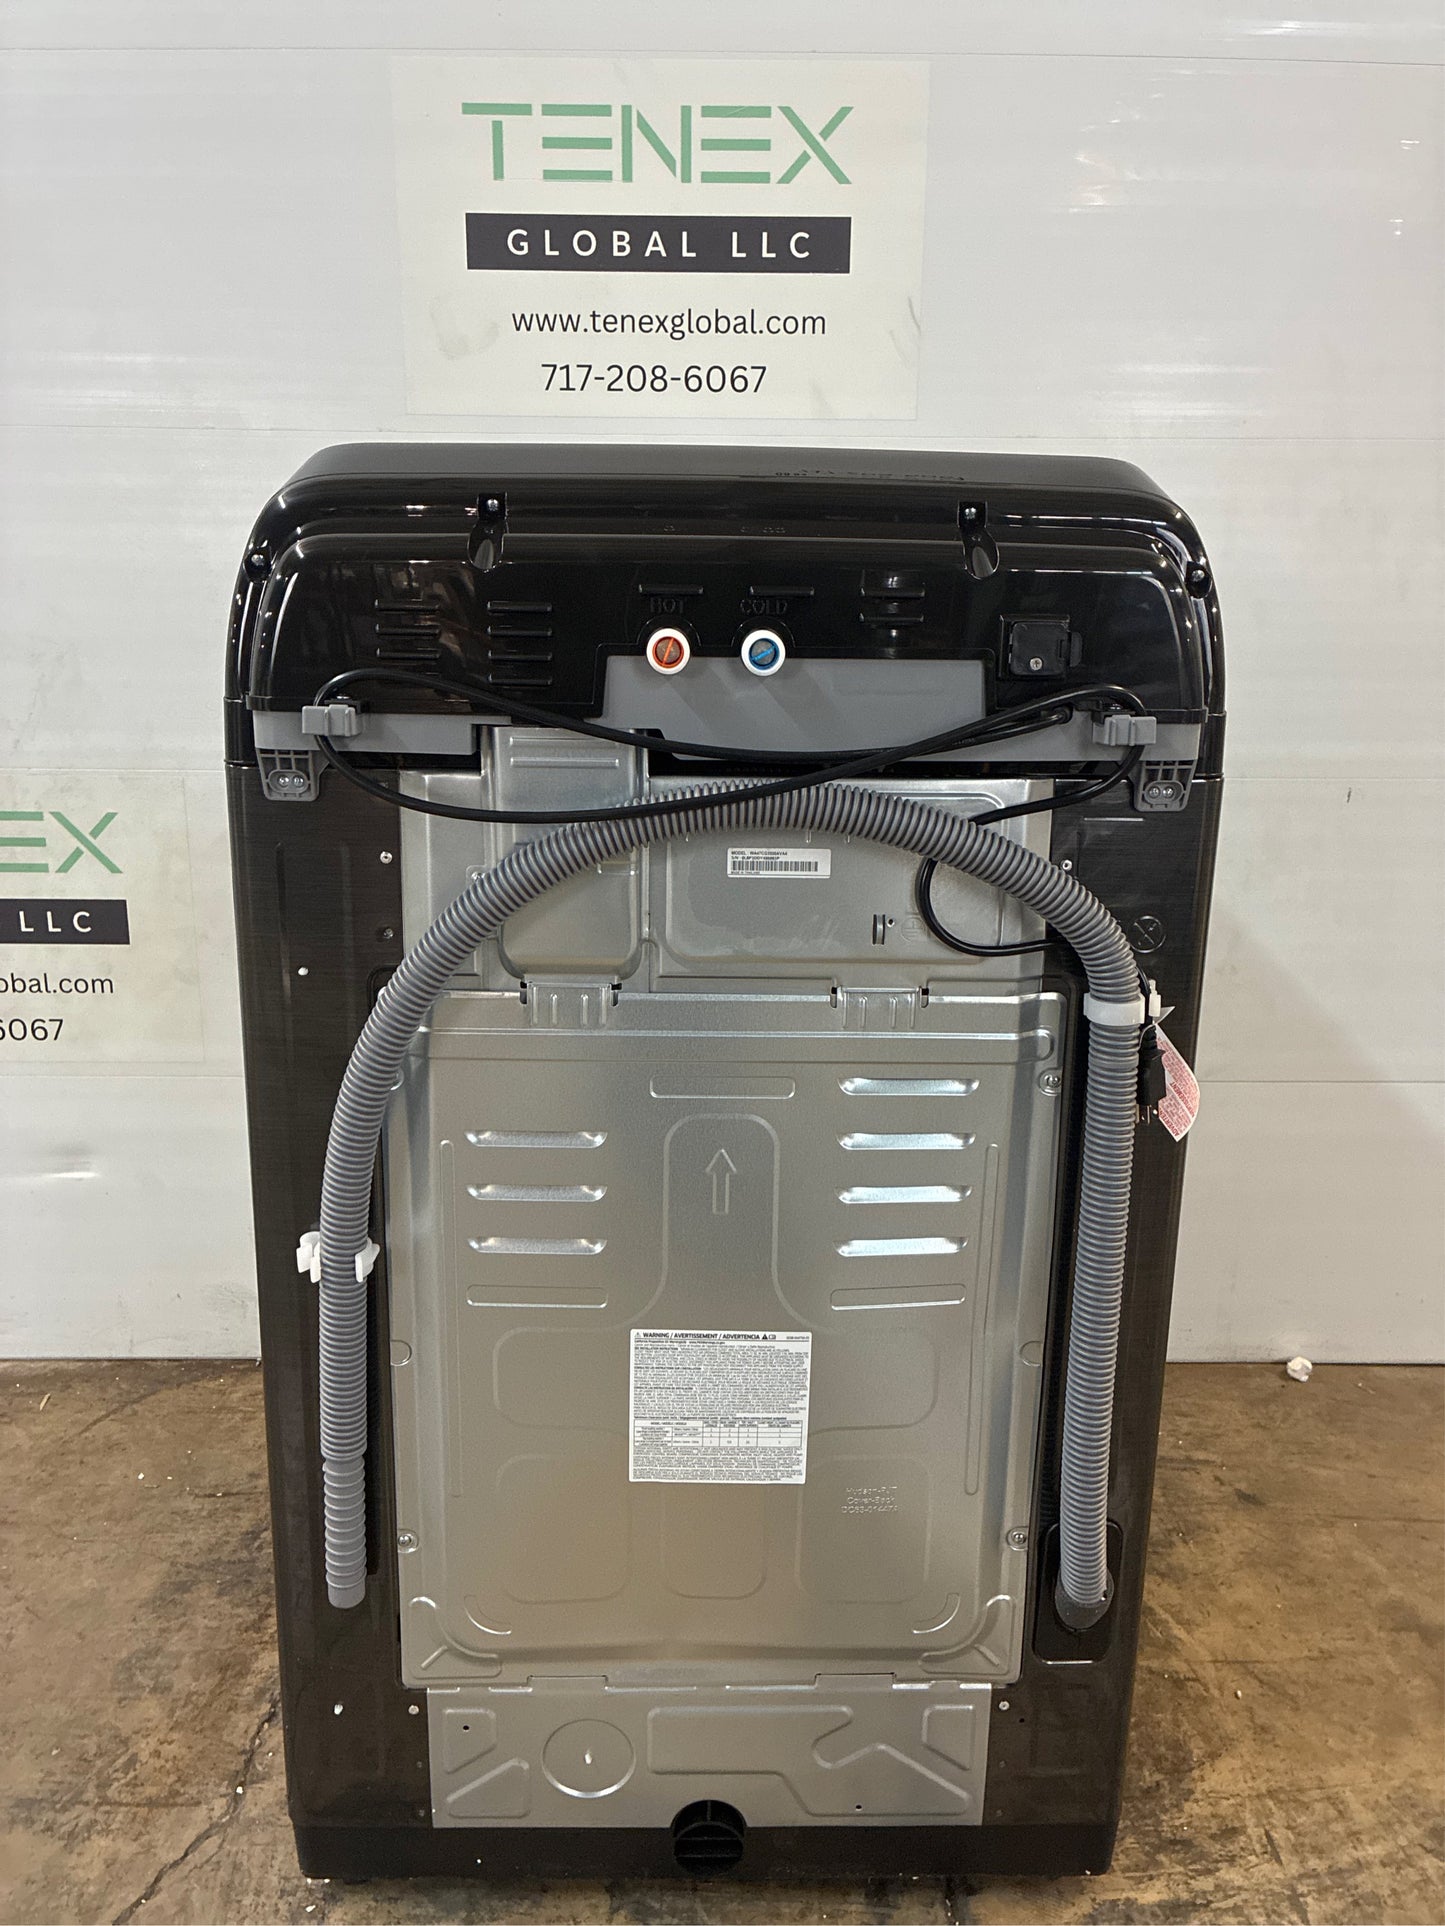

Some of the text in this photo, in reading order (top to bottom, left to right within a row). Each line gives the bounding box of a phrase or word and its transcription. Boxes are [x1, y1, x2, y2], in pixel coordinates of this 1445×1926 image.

[461, 102, 855, 185] TENEX
[506, 228, 812, 259] GLOBAL LLC
[511, 308, 827, 341] www.tenexglobal.com
[541, 363, 768, 394] 717-208-6067
[650, 598, 685, 613] HOT
[740, 599, 788, 614] COLD
[19, 910, 92, 933] LLC
